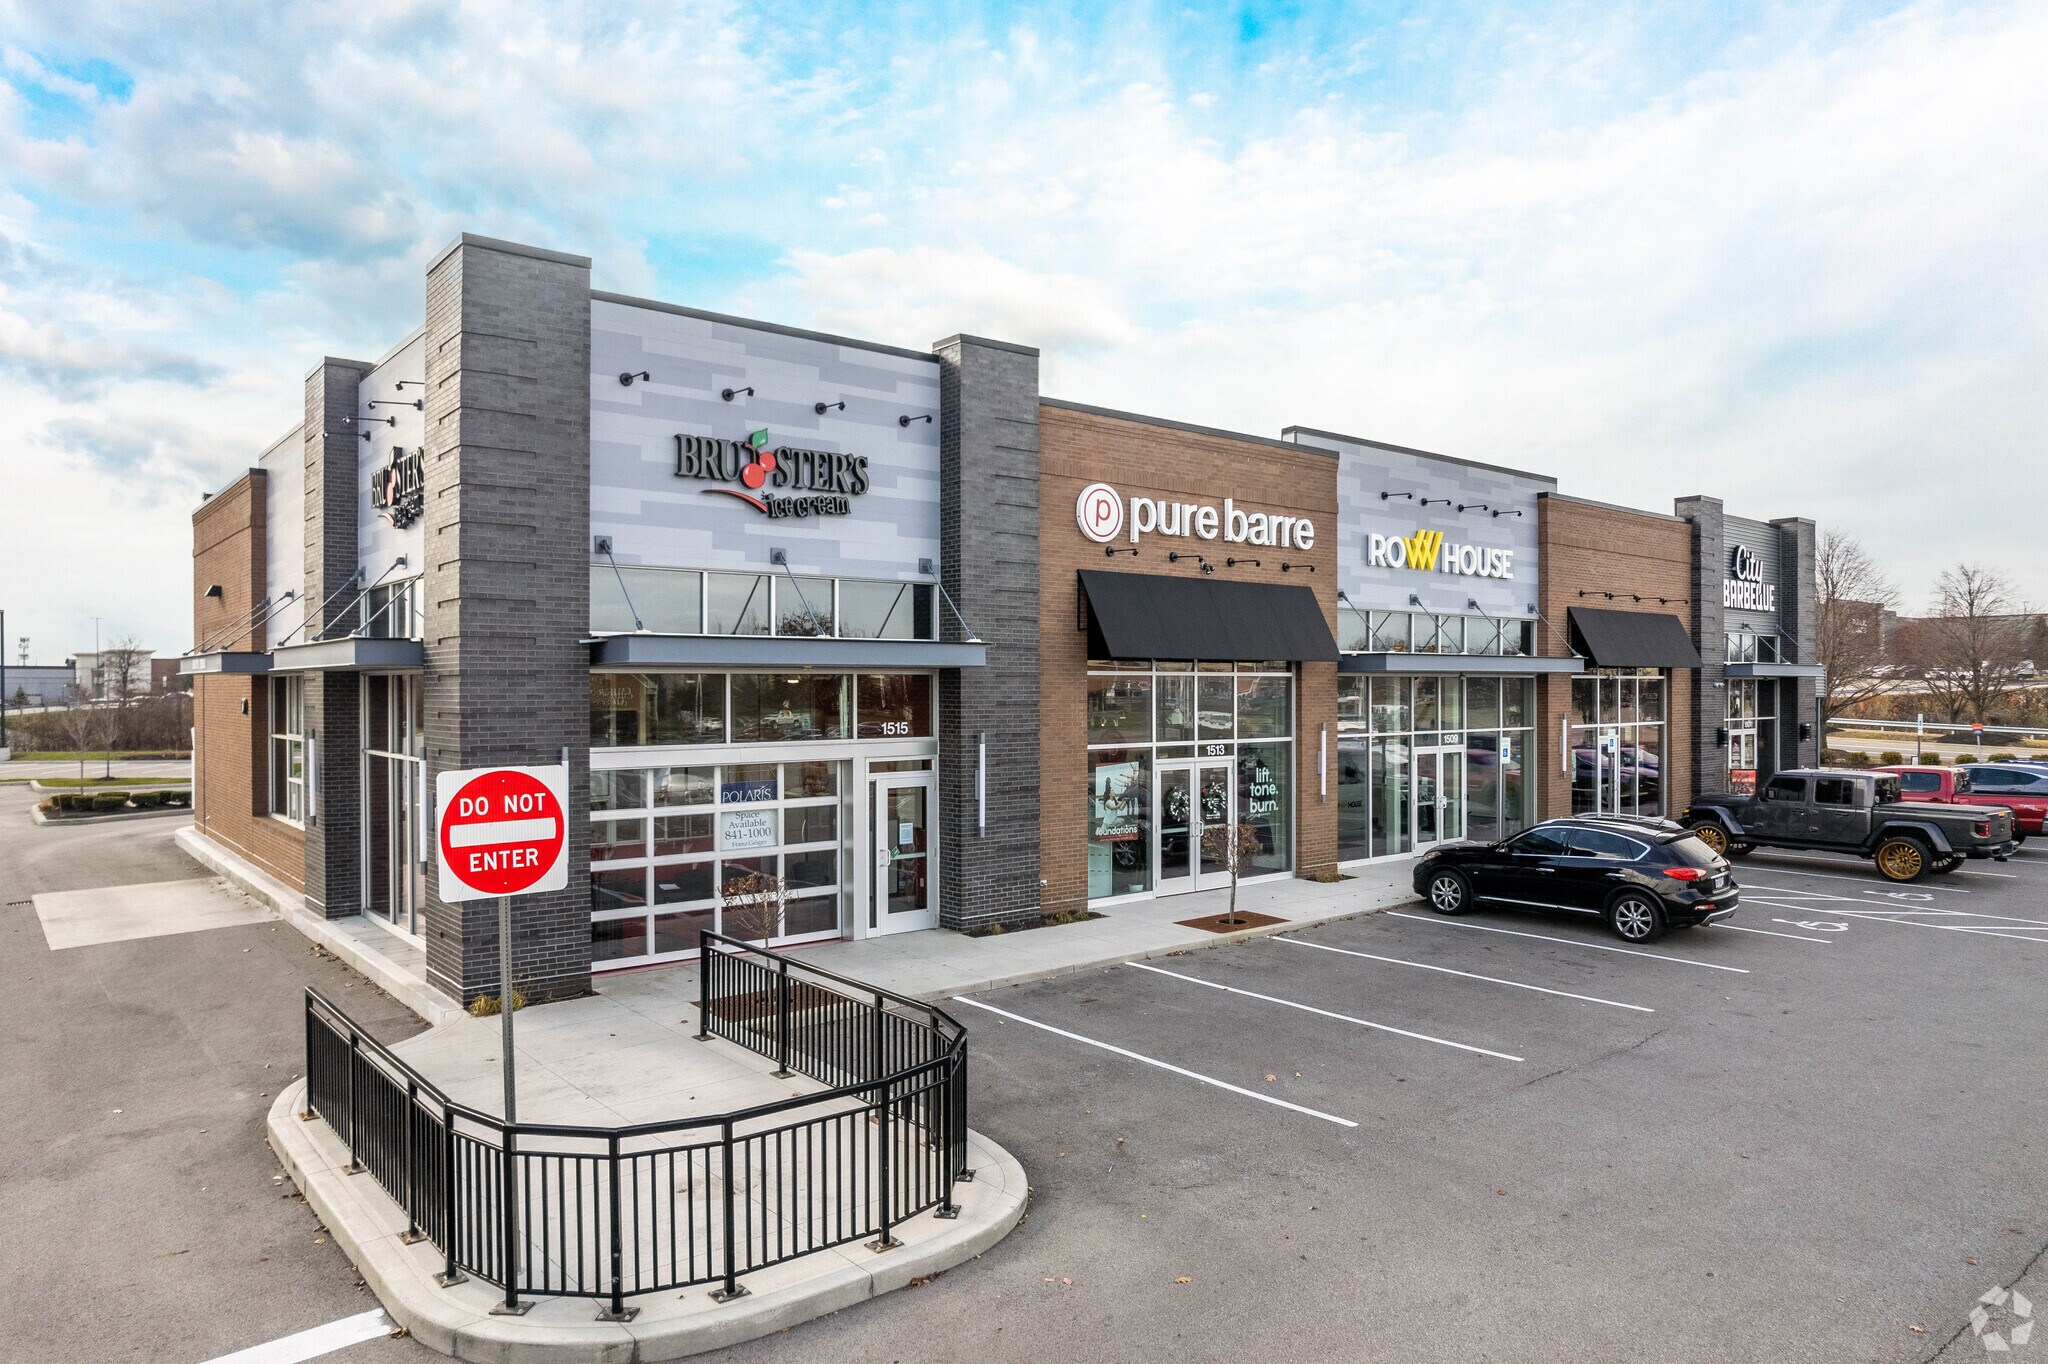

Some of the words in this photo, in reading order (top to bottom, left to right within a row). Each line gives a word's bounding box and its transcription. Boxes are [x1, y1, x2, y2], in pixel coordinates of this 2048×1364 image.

[768, 492, 794, 518] ice
[795, 495, 851, 518] cream
[1130, 497, 1219, 543] pure
[1224, 498, 1314, 550] barre
[1441, 542, 1514, 579] HOUSE
[1736, 545, 1763, 595] City
[1723, 579, 1775, 612] BARBEQUE
[881, 721, 908, 735] 1515
[1443, 734, 1459, 743] 1509
[1206, 745, 1225, 756] 1513
[1255, 767, 1272, 783] lift.
[1249, 783, 1279, 797] tone.
[460, 796, 489, 817] DO
[504, 792, 546, 814] NOT
[1249, 798, 1279, 814] burn.
[728, 819, 767, 829] Available
[735, 811, 760, 821] Space
[724, 827, 771, 840] 841-1000
[469, 848, 539, 873] ENTER
